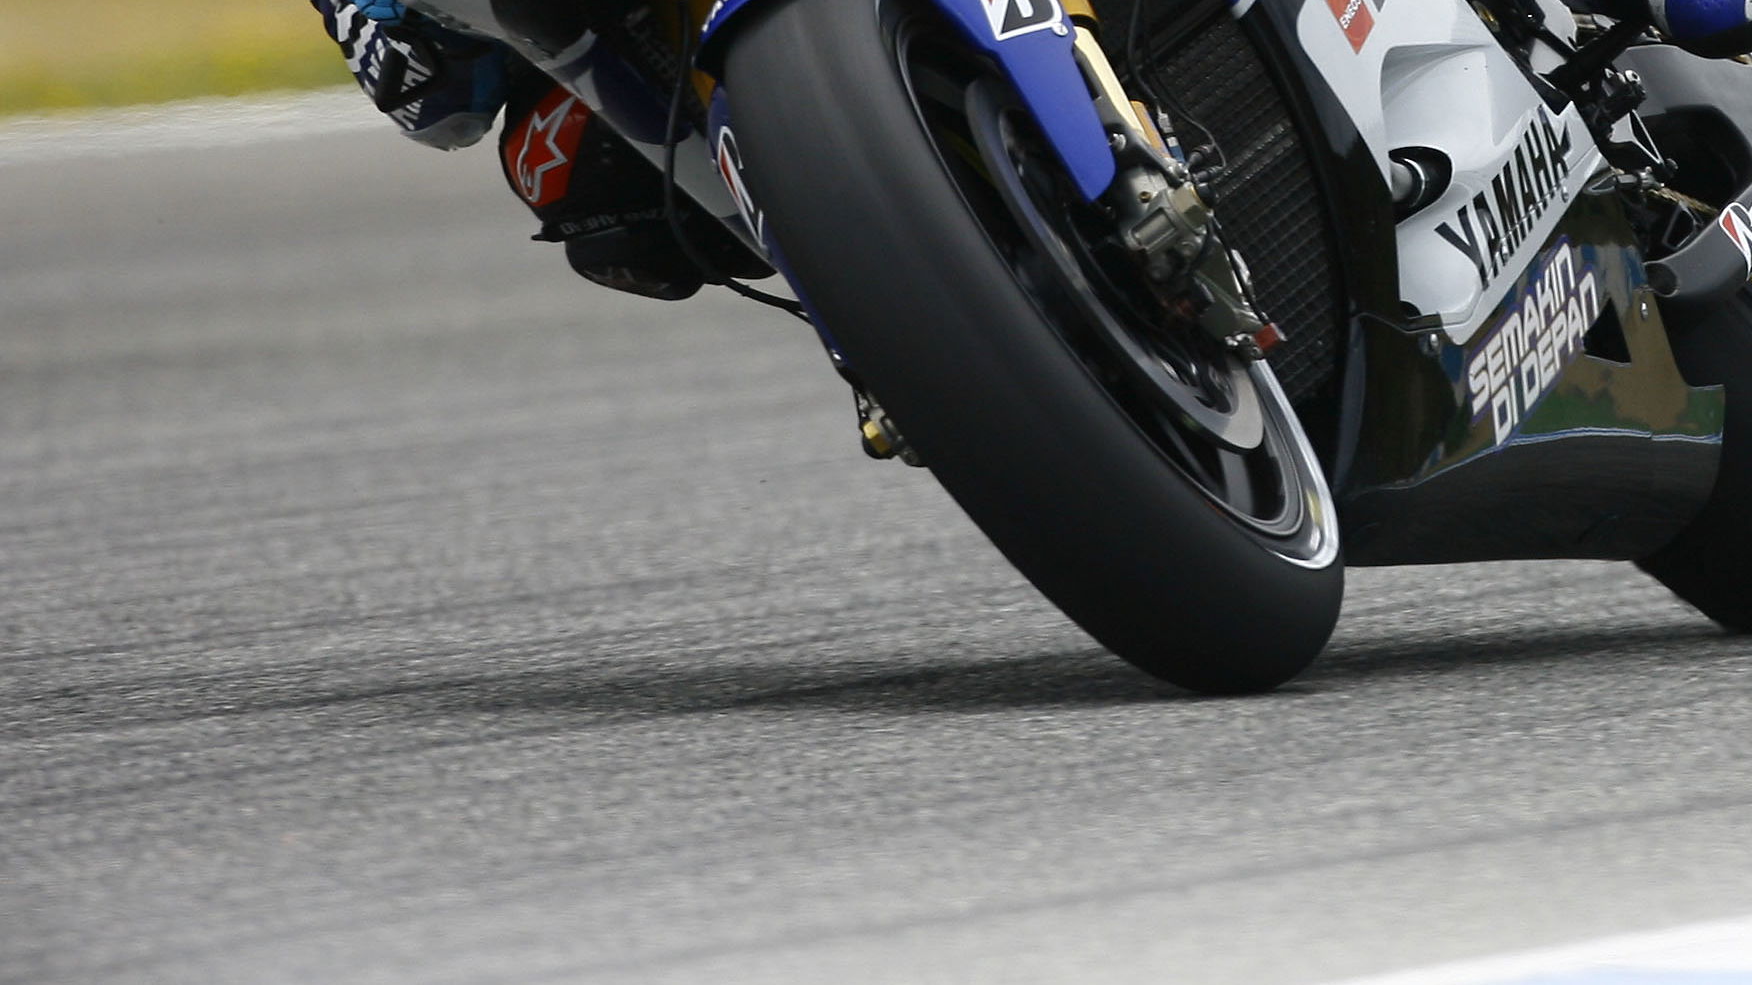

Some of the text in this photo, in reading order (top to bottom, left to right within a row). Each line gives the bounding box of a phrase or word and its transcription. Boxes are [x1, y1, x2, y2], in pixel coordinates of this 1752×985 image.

[1434, 103, 1572, 291] YAMAHA
[1468, 242, 1576, 415] SEMAKIN
[1491, 270, 1600, 447] DI DEPAN
